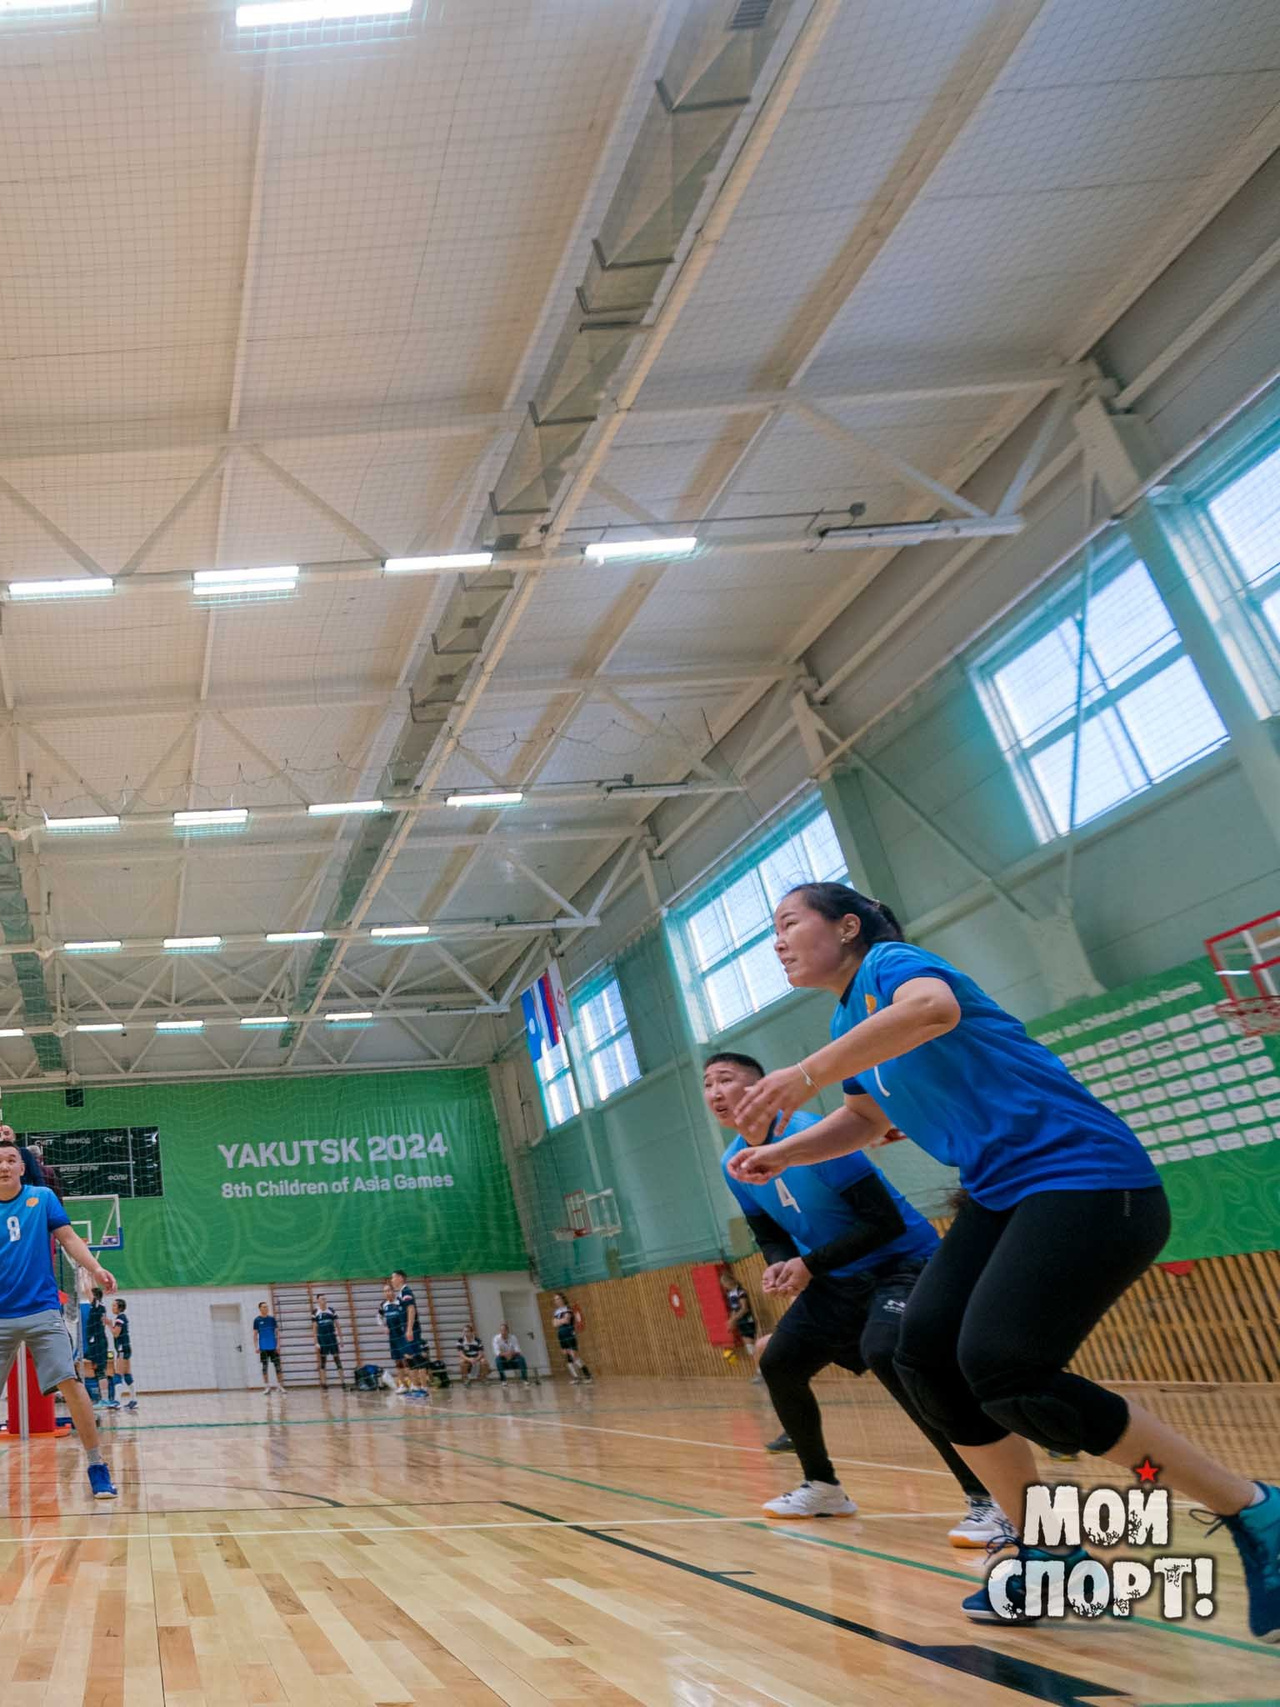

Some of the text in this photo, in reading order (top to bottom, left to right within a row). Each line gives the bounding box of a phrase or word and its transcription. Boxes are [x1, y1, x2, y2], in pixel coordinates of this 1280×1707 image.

[218, 1132, 448, 1169] YAKUTSK 2024
[222, 1173, 454, 1198] 8th Children of Asia Games
[774, 1177, 801, 1214] 4
[6, 1215, 21, 1242] 8
